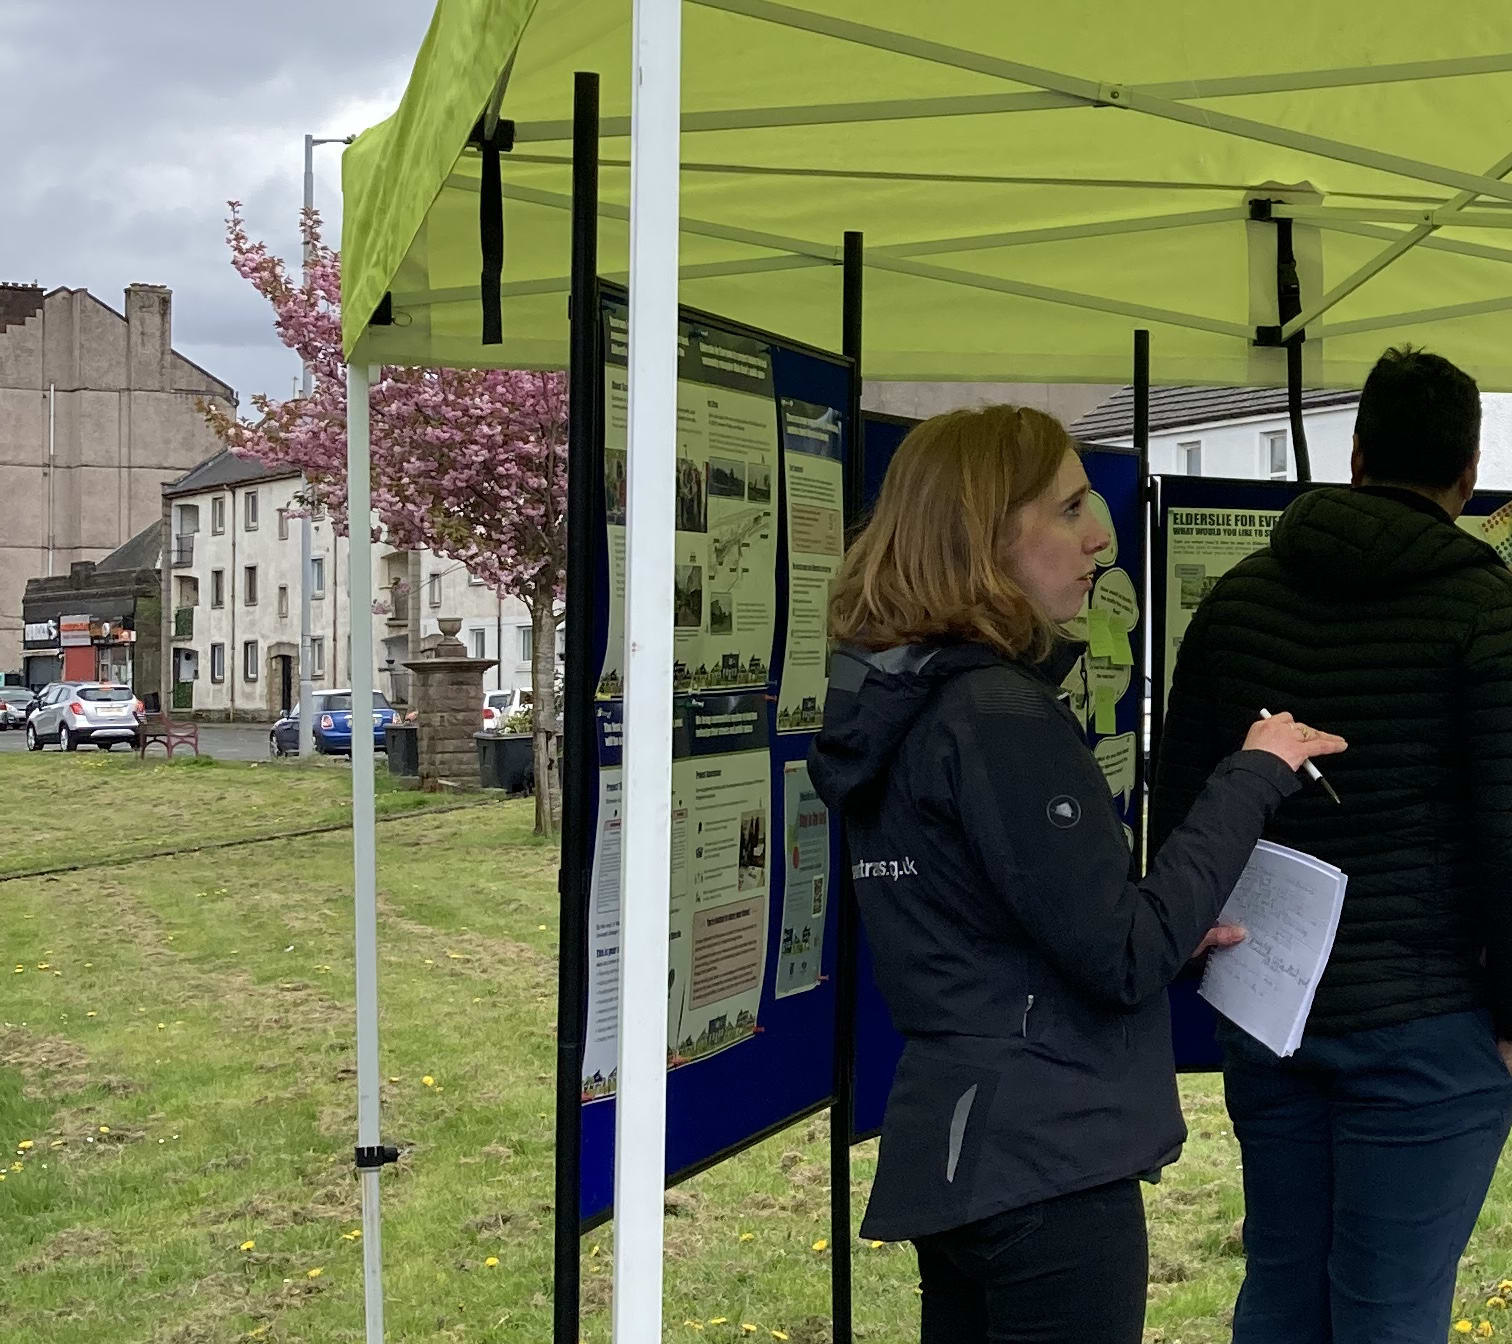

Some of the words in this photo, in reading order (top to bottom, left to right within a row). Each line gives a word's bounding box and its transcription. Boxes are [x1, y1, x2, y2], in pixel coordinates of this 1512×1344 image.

[1172, 513, 1232, 527] ELDERSLIE
[1234, 514, 1256, 527] FOR
[1173, 527, 1194, 536] WHAT
[1195, 527, 1221, 536] WOULD
[1223, 528, 1237, 536] YOU
[1238, 528, 1253, 537] LIKE
